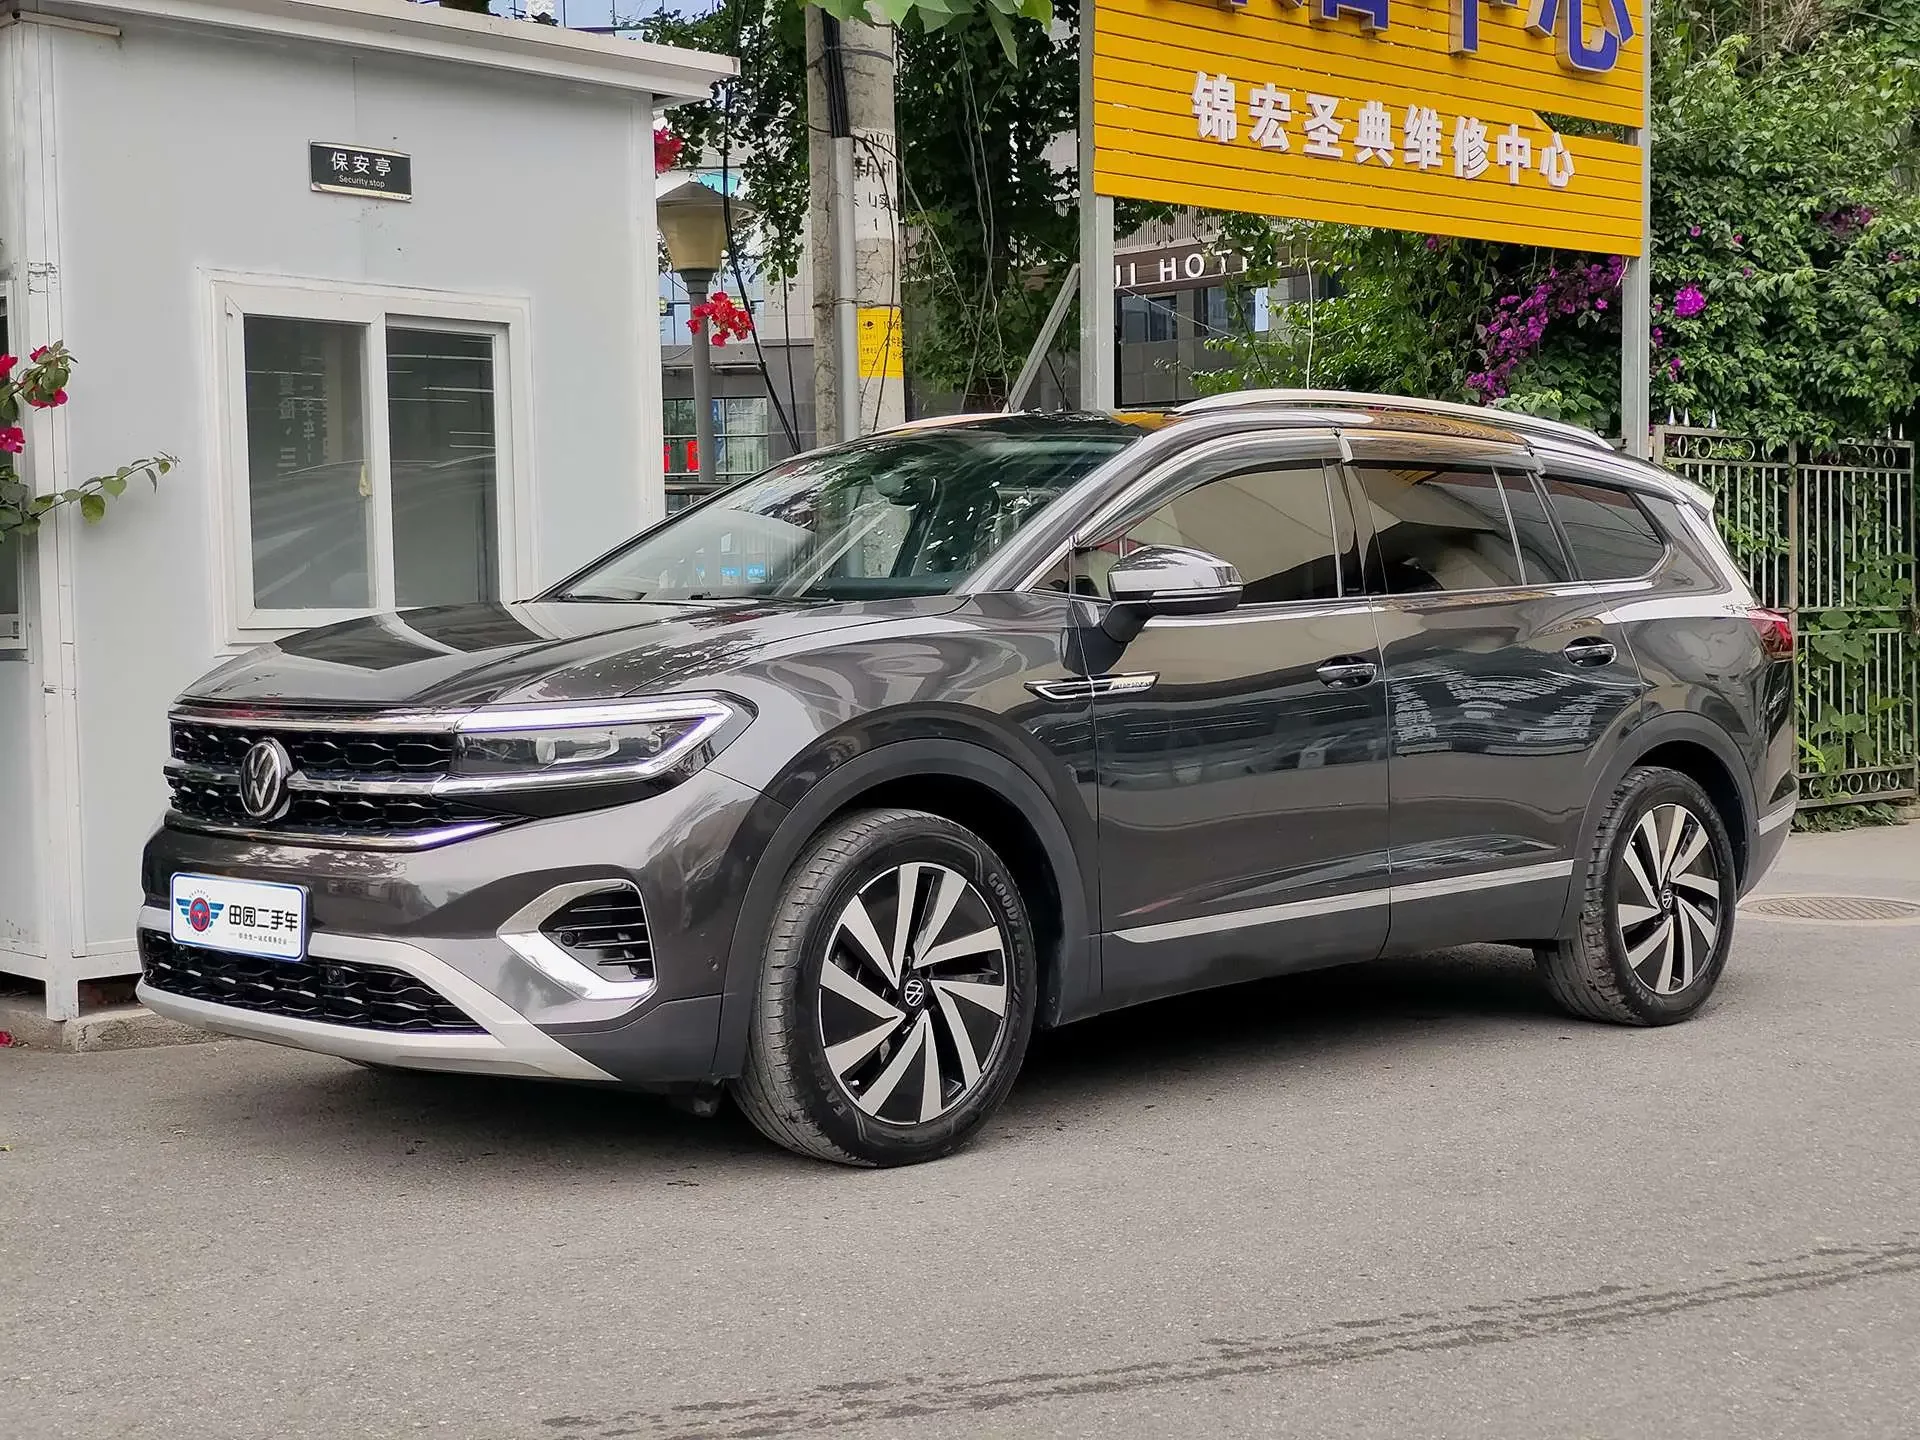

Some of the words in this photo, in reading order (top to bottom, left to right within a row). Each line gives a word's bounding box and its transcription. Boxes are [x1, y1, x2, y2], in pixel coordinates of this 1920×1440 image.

[1191, 70, 1576, 188] 锦宏圣典维修中心
[331, 151, 392, 177] 保安亭
[339, 174, 368, 187] Security
[369, 179, 386, 189] stop
[229, 904, 298, 932] 田园二手车
